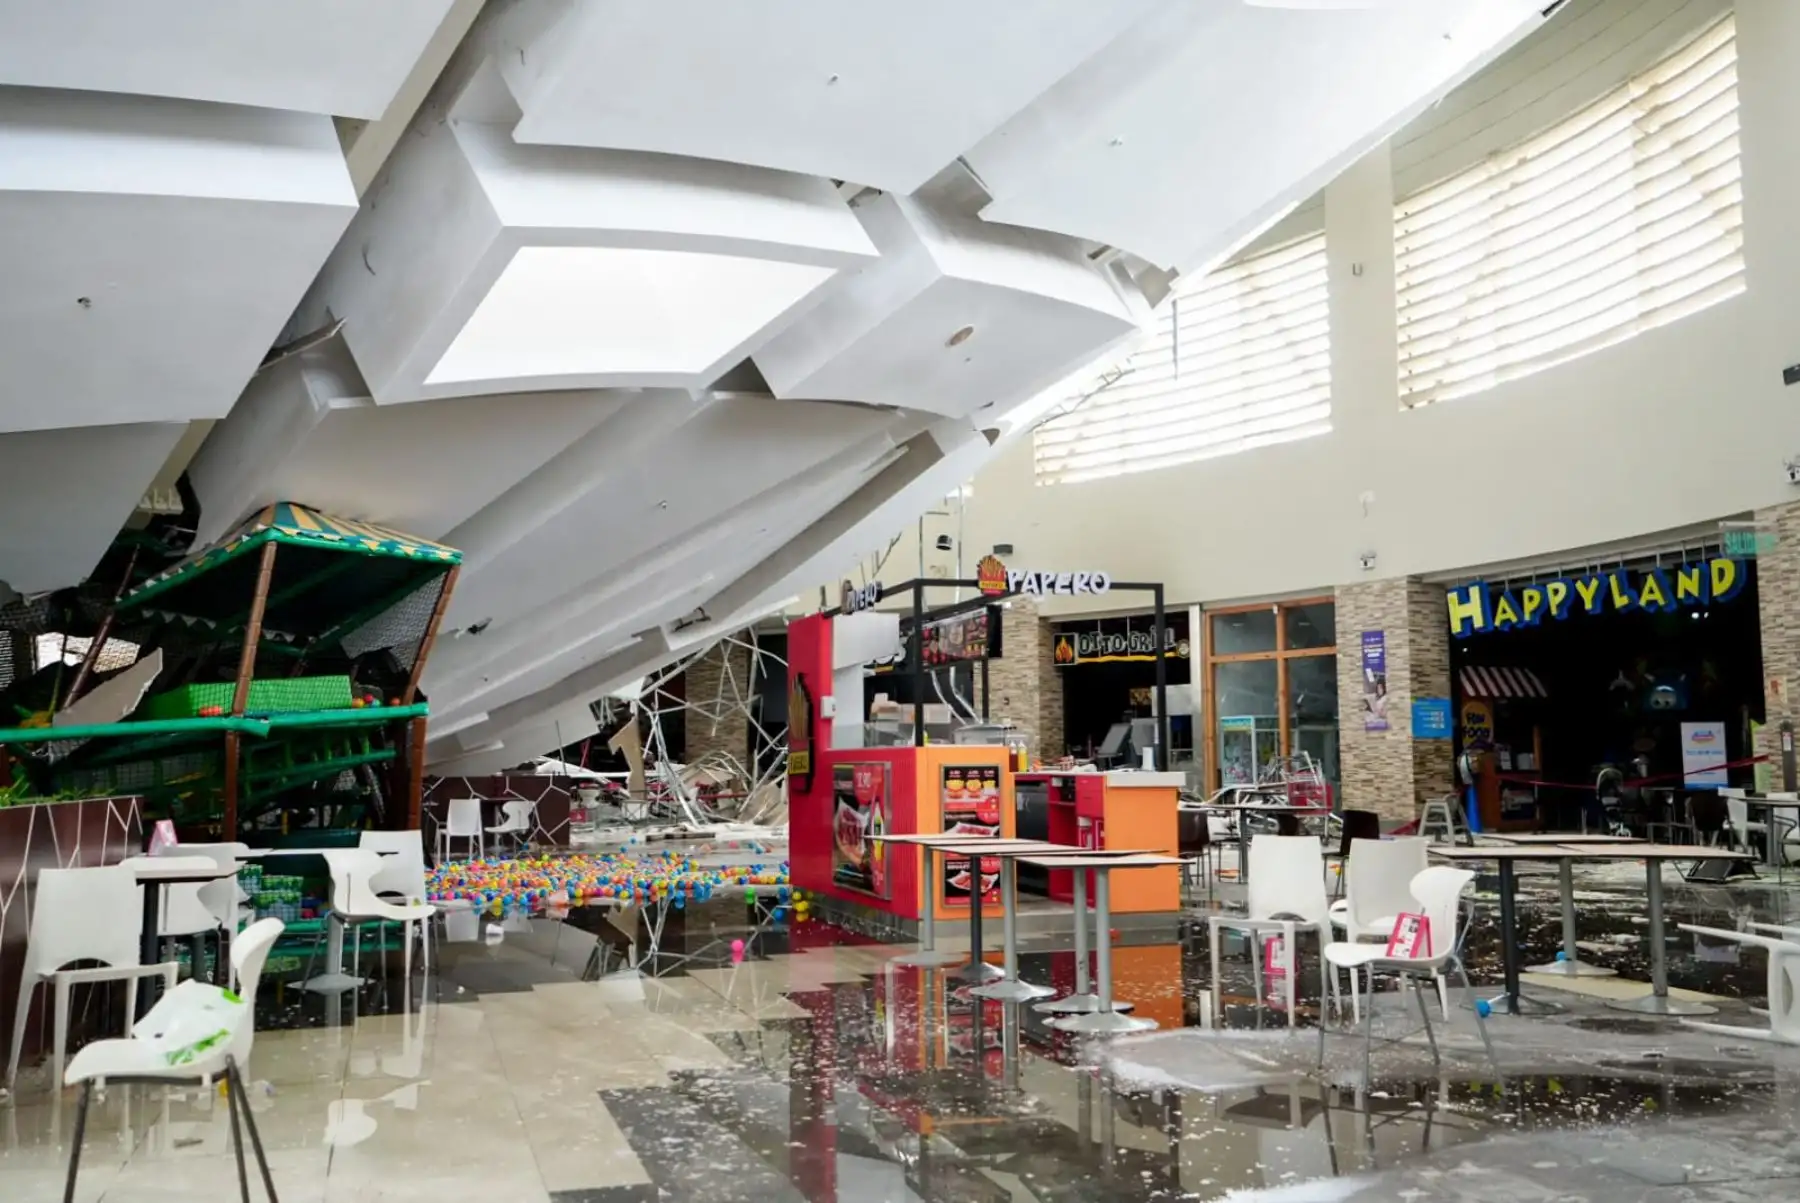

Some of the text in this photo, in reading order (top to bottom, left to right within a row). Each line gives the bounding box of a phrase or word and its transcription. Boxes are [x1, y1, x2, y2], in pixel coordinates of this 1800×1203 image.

[1006, 569, 1111, 596] PAPERO
[1446, 558, 1737, 634] HAPPYLAND
[1079, 630, 1126, 654] OTTO
